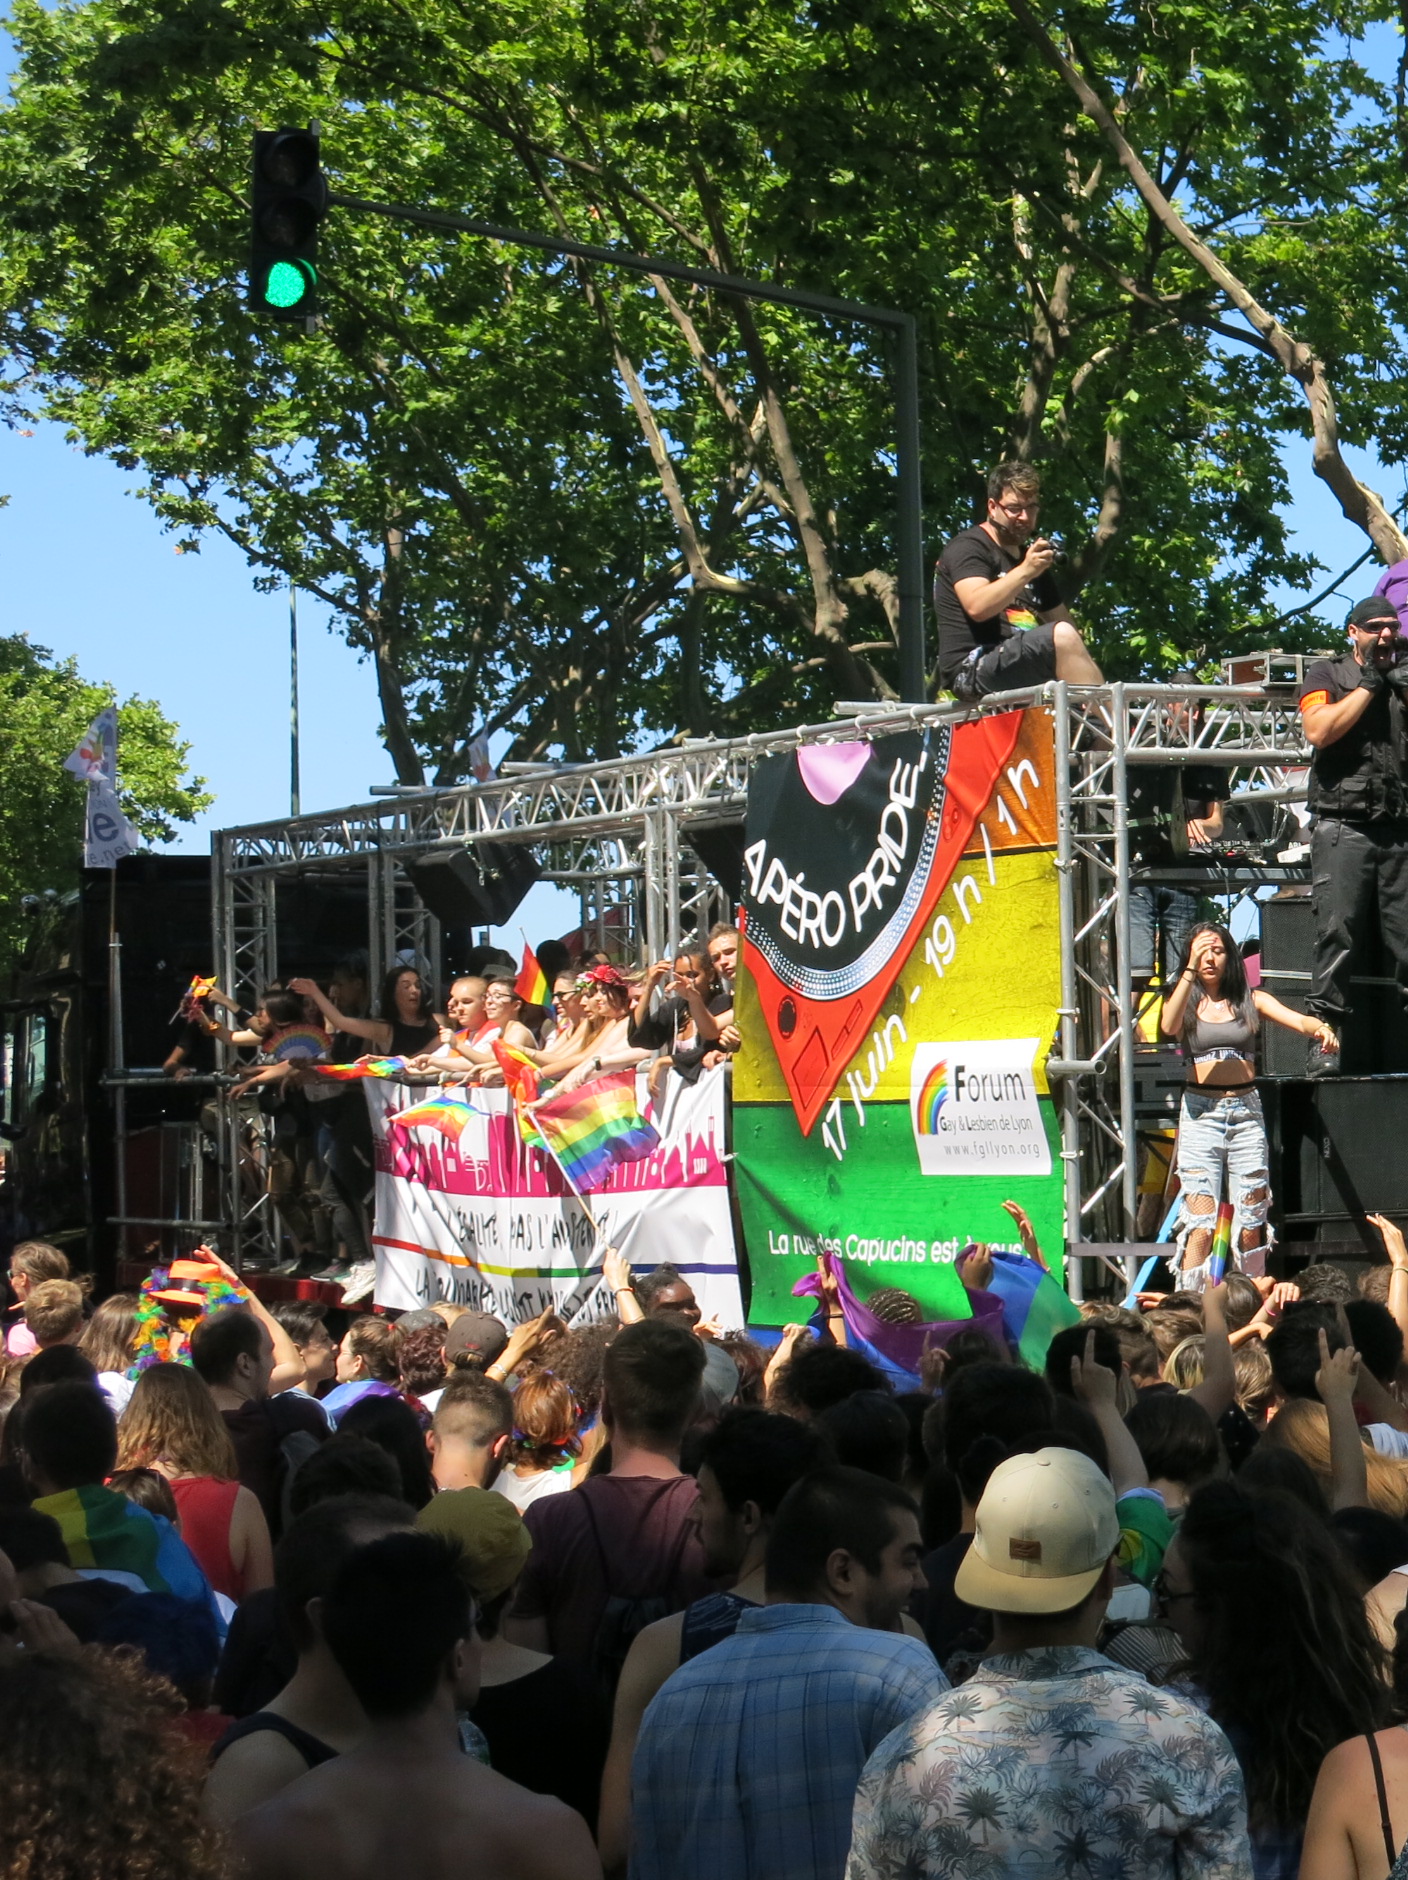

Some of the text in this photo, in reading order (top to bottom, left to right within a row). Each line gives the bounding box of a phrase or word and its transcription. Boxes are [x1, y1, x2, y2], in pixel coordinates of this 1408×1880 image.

[743, 757, 919, 948] APÉRO PRIDE
[821, 1097, 847, 1161] 17
[846, 1013, 908, 1127] juin
[925, 914, 956, 978] 19
[953, 1064, 1027, 1103] Forum
[939, 1113, 1034, 1135] Gay & Lesbien de Lyon
[943, 1140, 1041, 1160] www.fgllyon.org
[767, 1229, 790, 1255] La
[793, 1234, 816, 1256] rue
[816, 1232, 842, 1258] des
[844, 1233, 926, 1267] Capucins
[930, 1236, 959, 1264] est
